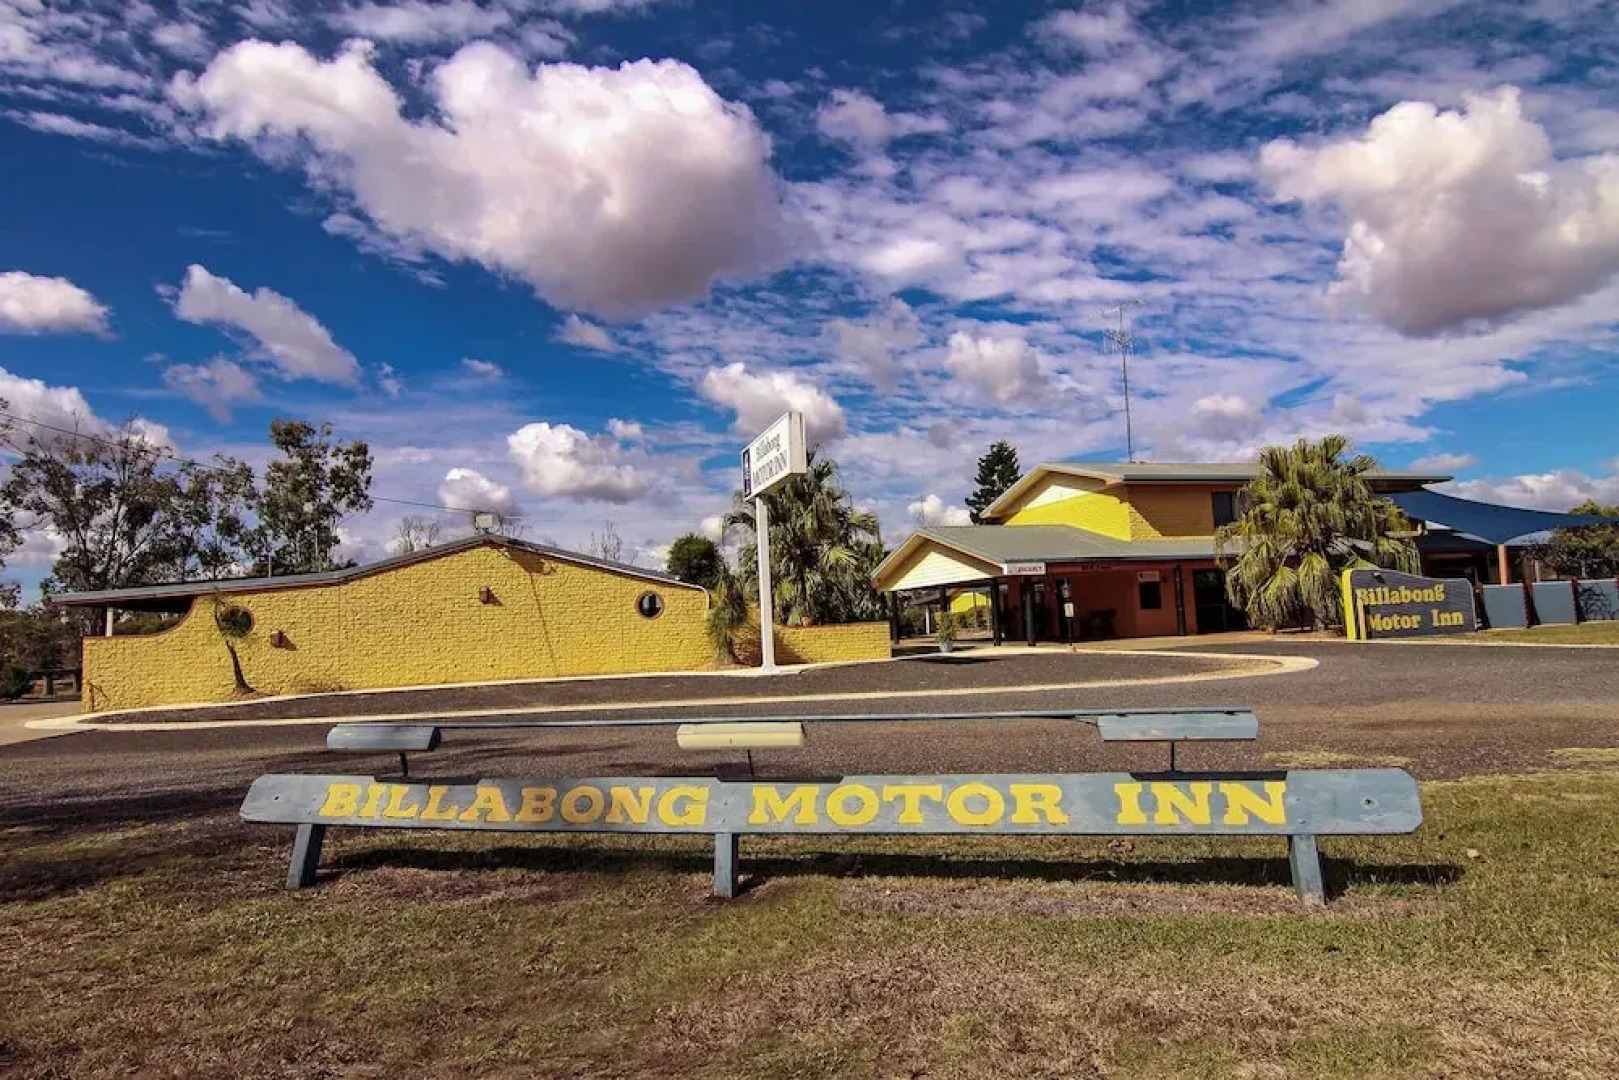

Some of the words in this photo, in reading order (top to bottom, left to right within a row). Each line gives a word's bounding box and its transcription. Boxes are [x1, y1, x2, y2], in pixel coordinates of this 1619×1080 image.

[1356, 583, 1445, 605] Billabong
[1367, 613, 1420, 631] Motor
[1431, 609, 1464, 626] Inn
[319, 783, 711, 826] BILLABONG
[747, 783, 1069, 825] MOTOR
[1114, 781, 1288, 825] INN
